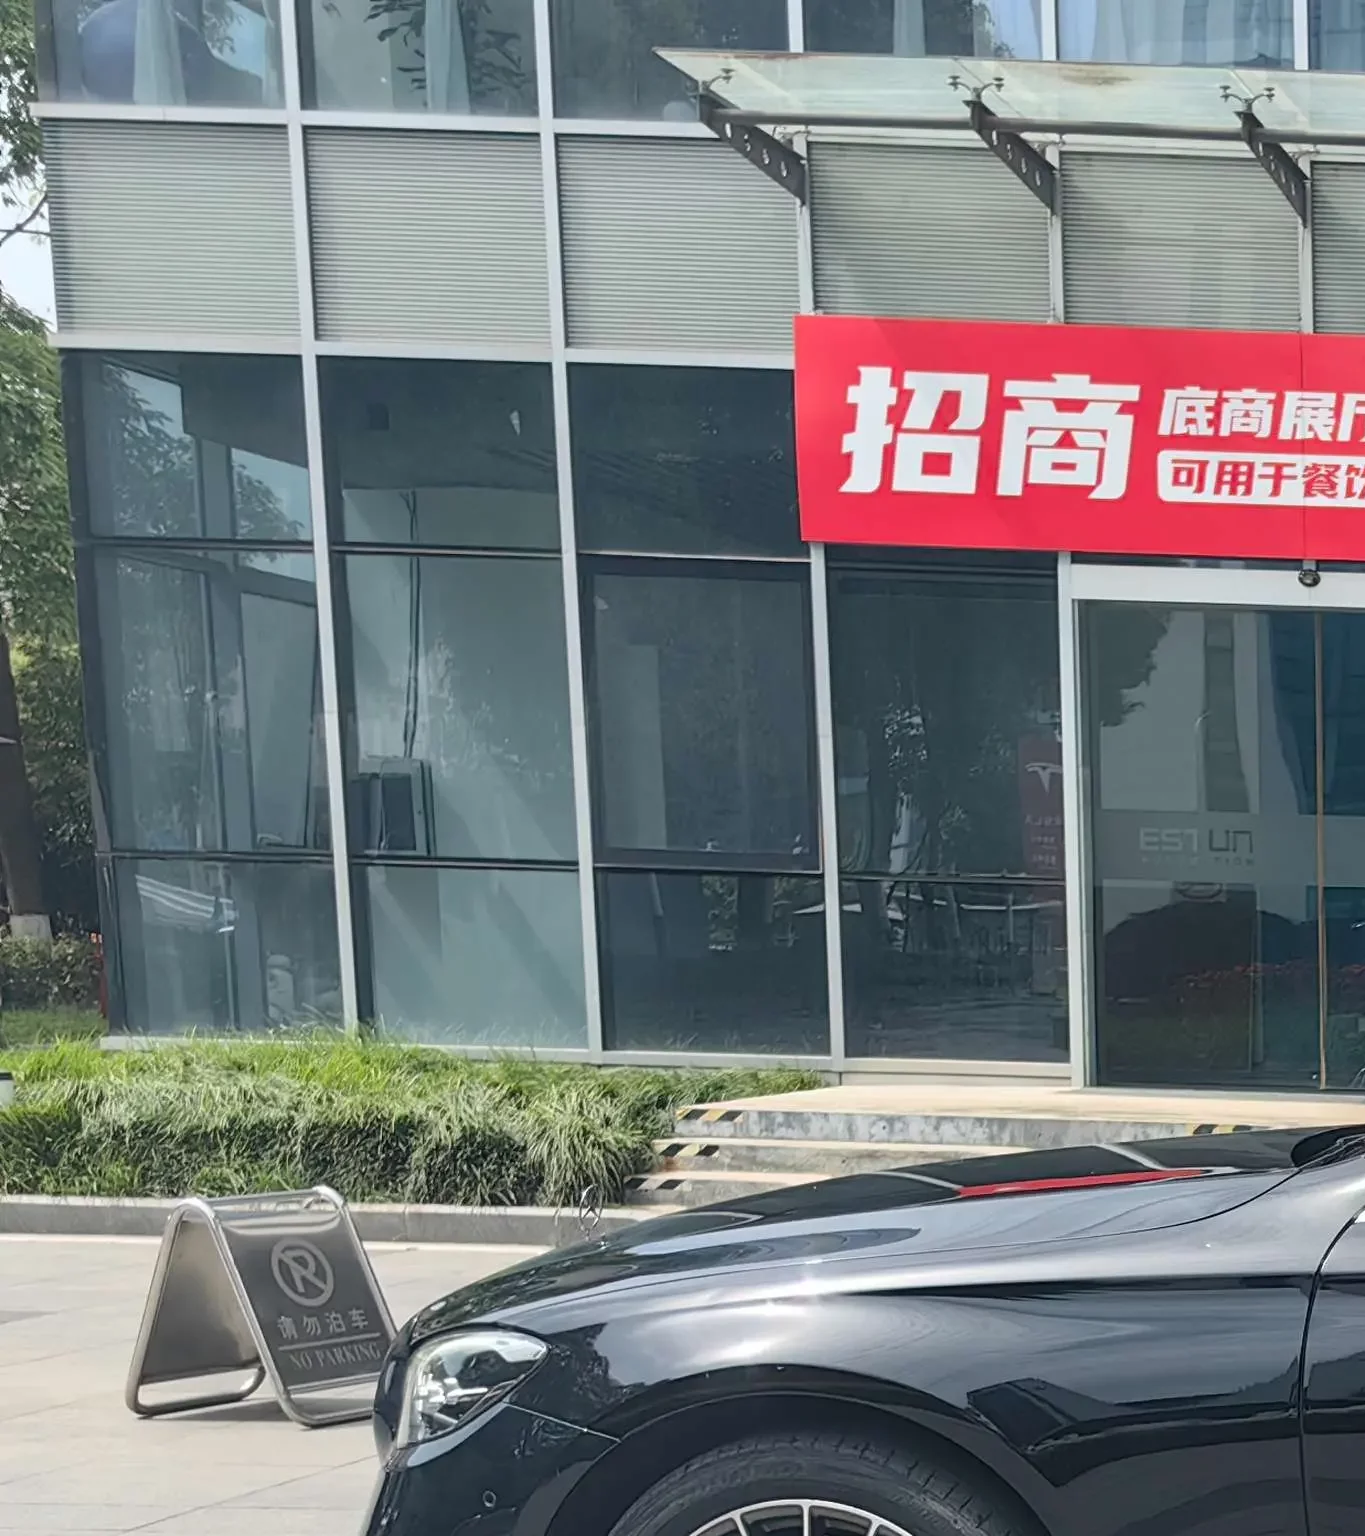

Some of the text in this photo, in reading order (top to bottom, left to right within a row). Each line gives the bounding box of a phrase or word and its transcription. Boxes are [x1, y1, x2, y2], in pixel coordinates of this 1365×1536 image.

[839, 366, 1140, 499] 招商
[276, 1307, 369, 1340] 请勿泊车
[289, 1341, 382, 1371] NO PARKING
